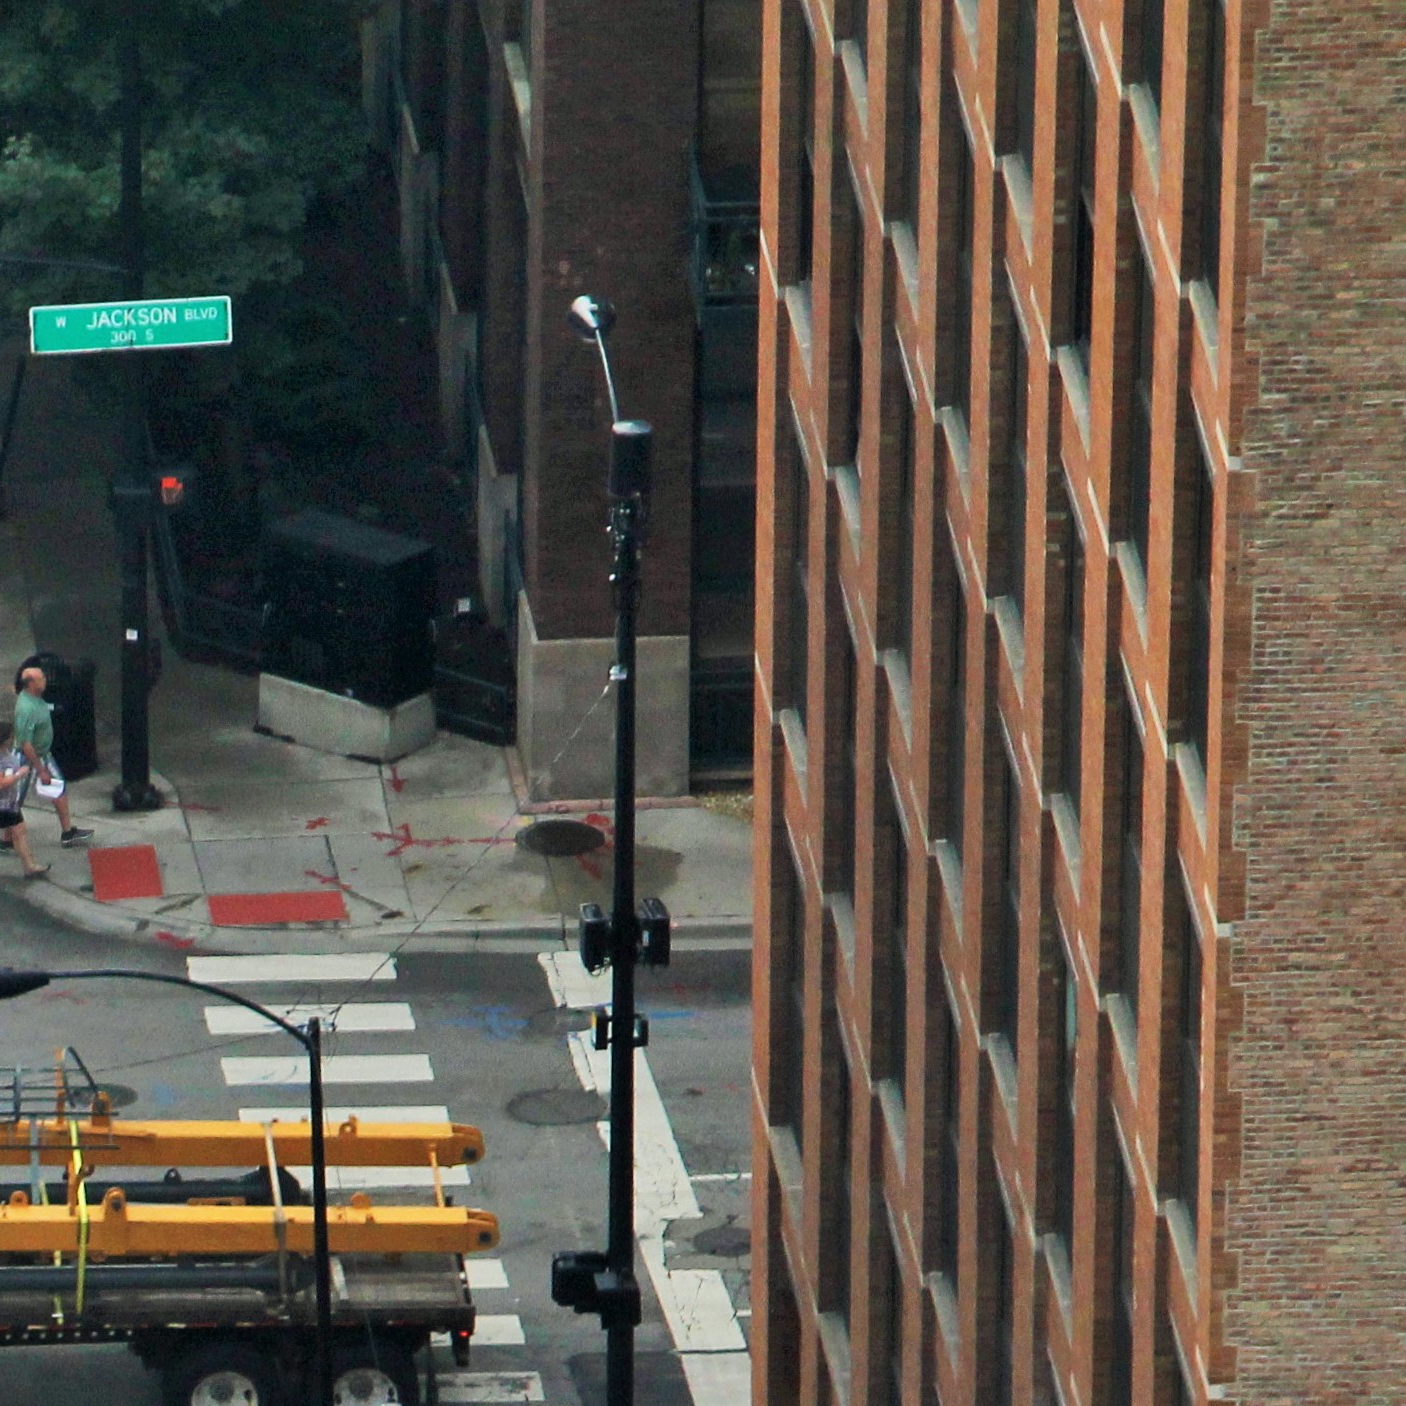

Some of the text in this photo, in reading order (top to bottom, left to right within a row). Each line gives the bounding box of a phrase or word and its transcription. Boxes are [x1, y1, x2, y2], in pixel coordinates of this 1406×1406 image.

[55, 306, 218, 331] W JACKSON BLVD
[110, 328, 154, 344] 300 S
